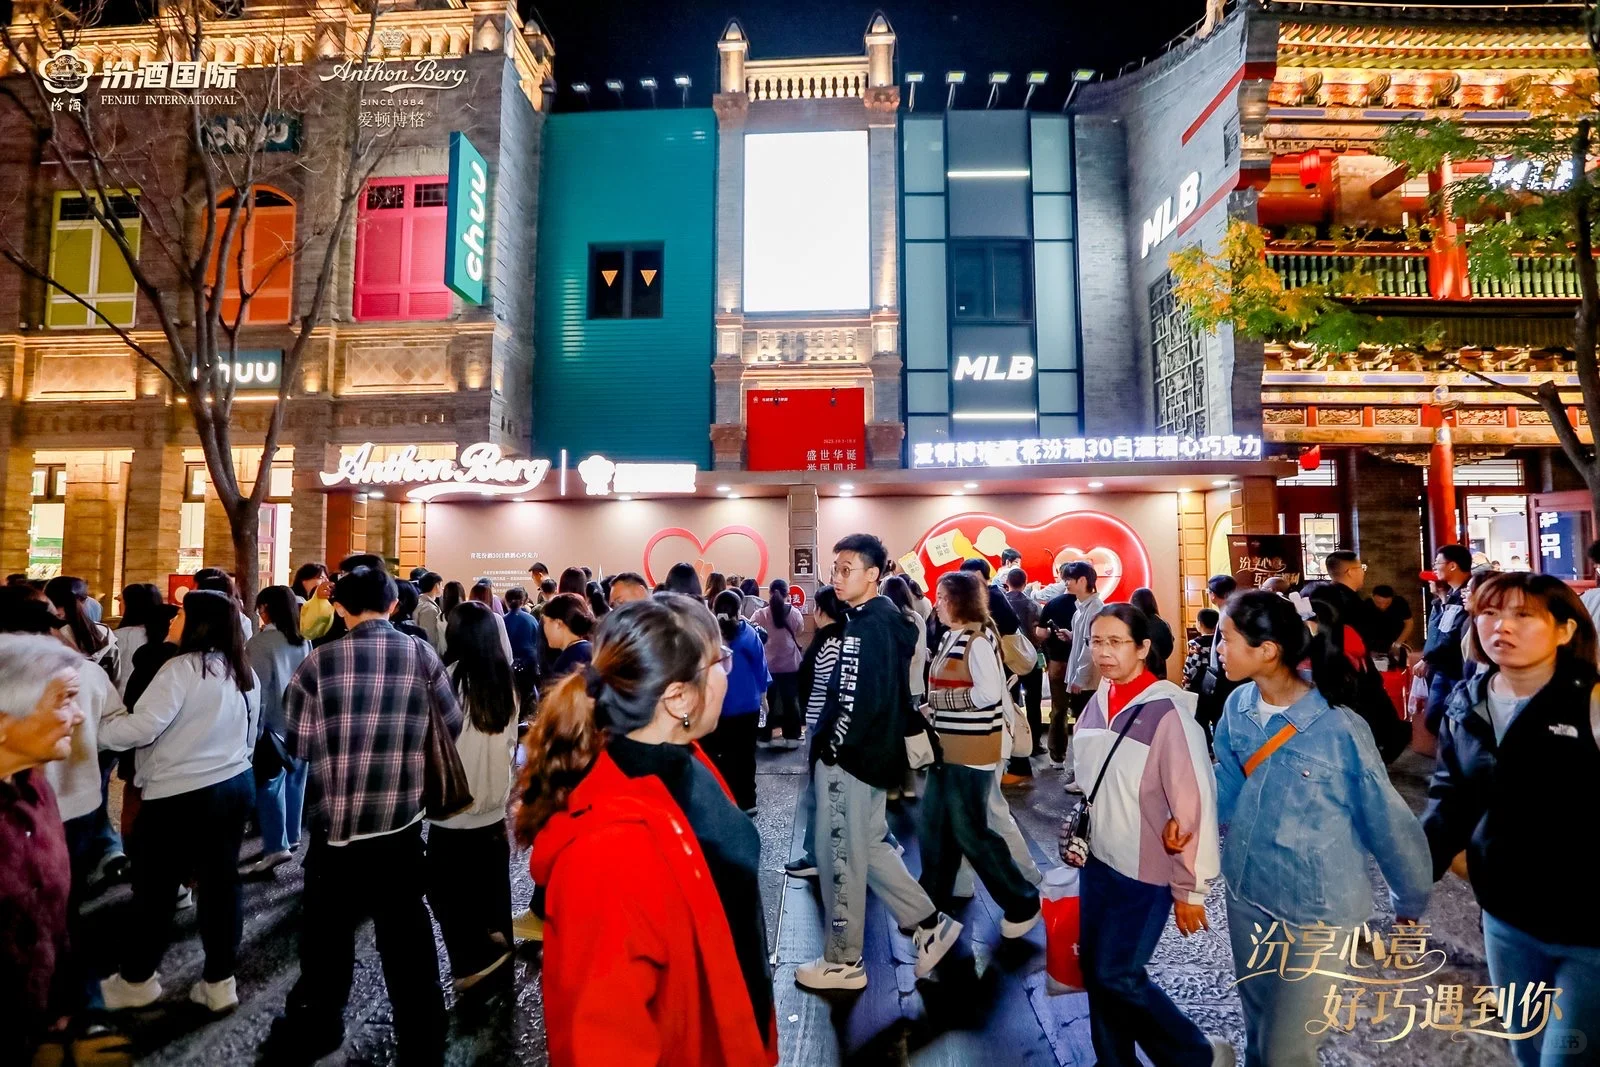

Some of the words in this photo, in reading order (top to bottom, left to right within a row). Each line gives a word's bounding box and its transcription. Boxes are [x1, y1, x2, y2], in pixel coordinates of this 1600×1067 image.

[462, 160, 487, 282] chuu
[1141, 171, 1200, 259] MLB
[192, 355, 277, 383] huu
[954, 355, 1034, 380] MLB
[320, 442, 455, 486] Anthon
[450, 442, 551, 494] Berg
[840, 655, 859, 691] FEAR
